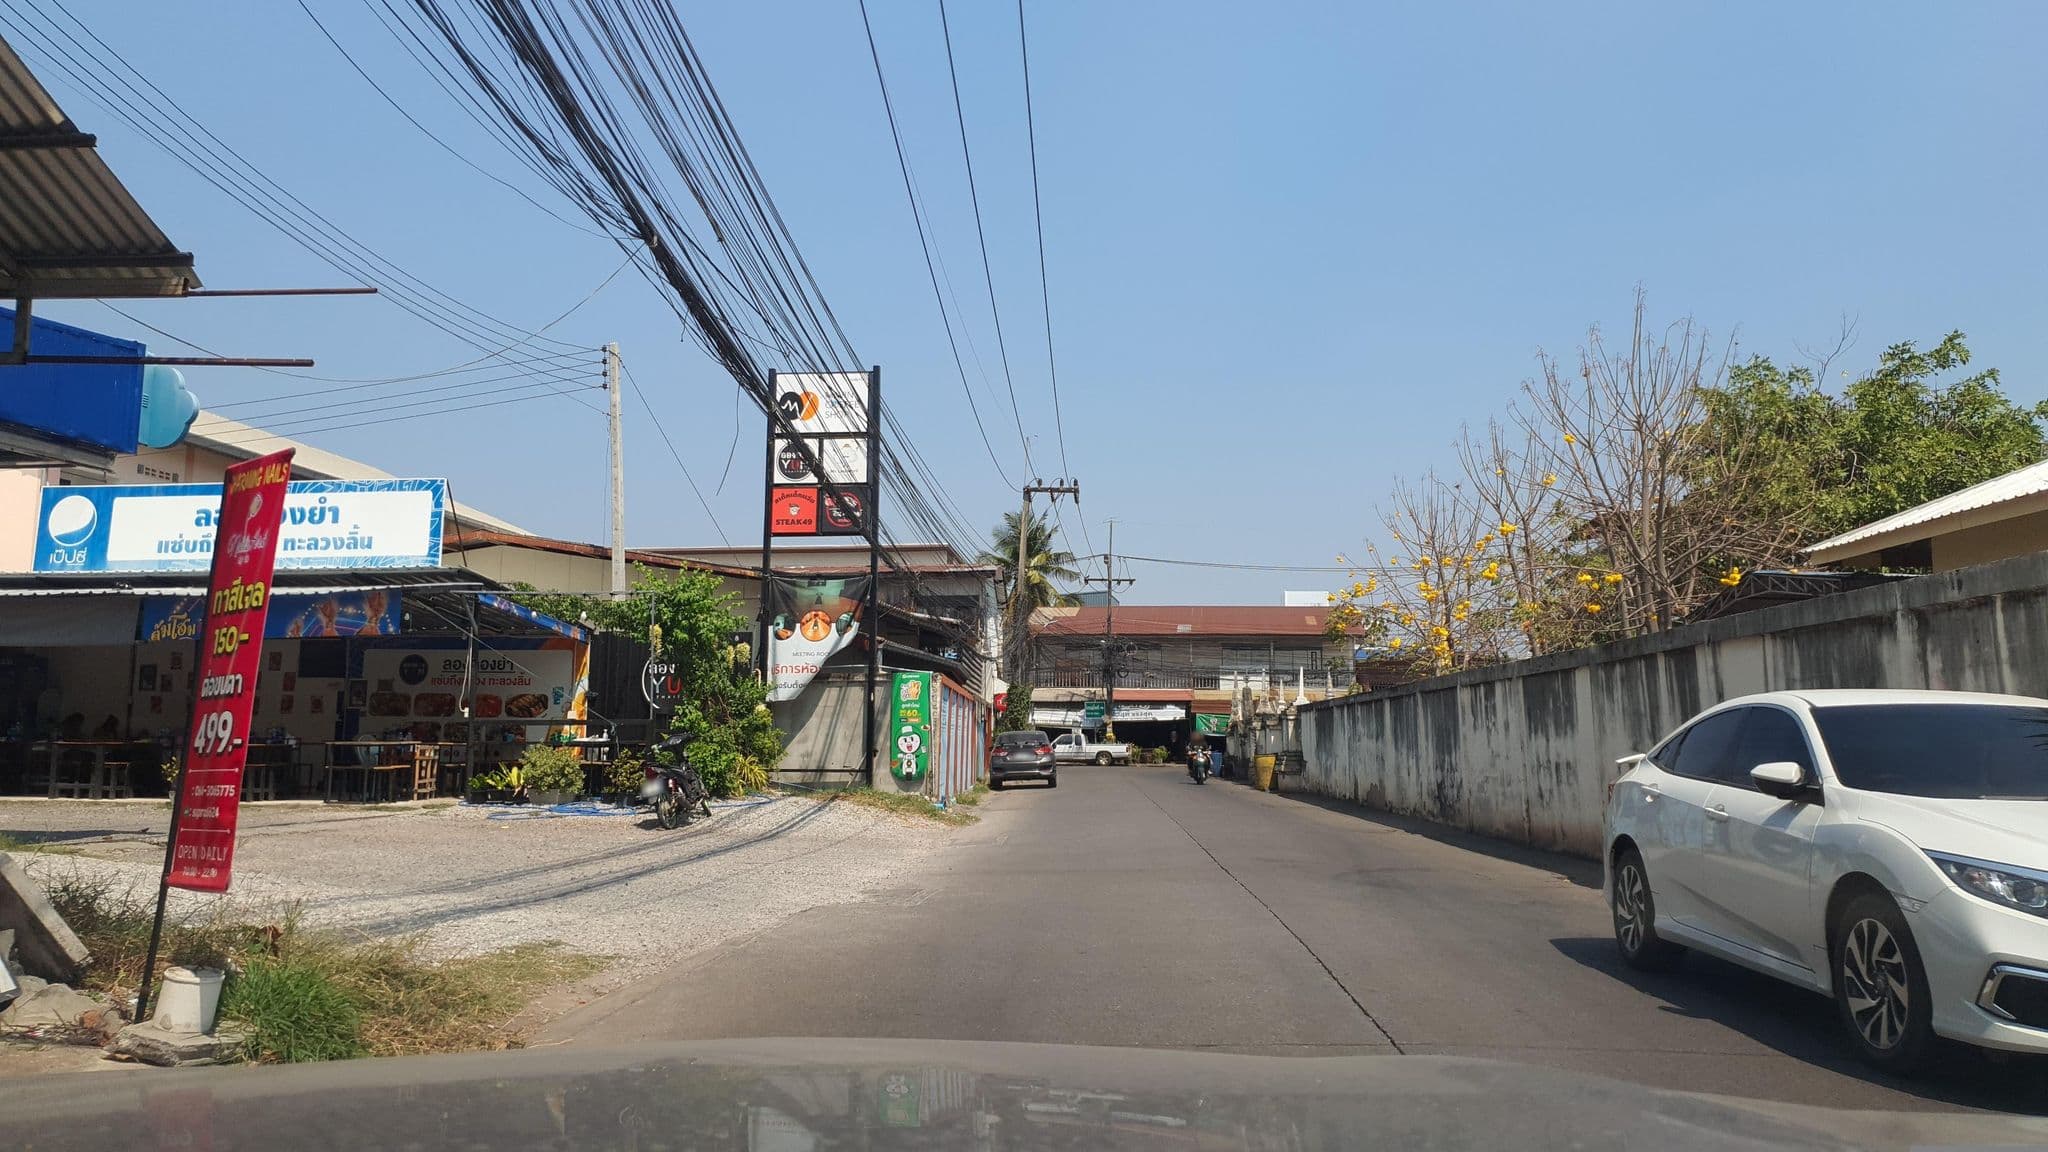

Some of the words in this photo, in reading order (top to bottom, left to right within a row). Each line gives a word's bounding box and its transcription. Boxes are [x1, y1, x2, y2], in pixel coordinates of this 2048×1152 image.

[283, 524, 373, 551] ทะลวงลิ้น
[212, 577, 265, 614] ทาสีเจล
[201, 670, 243, 697] ต่อขนตา
[194, 710, 242, 754] 499.-
[178, 845, 198, 860] OPEN
[200, 846, 229, 861] DAILY
